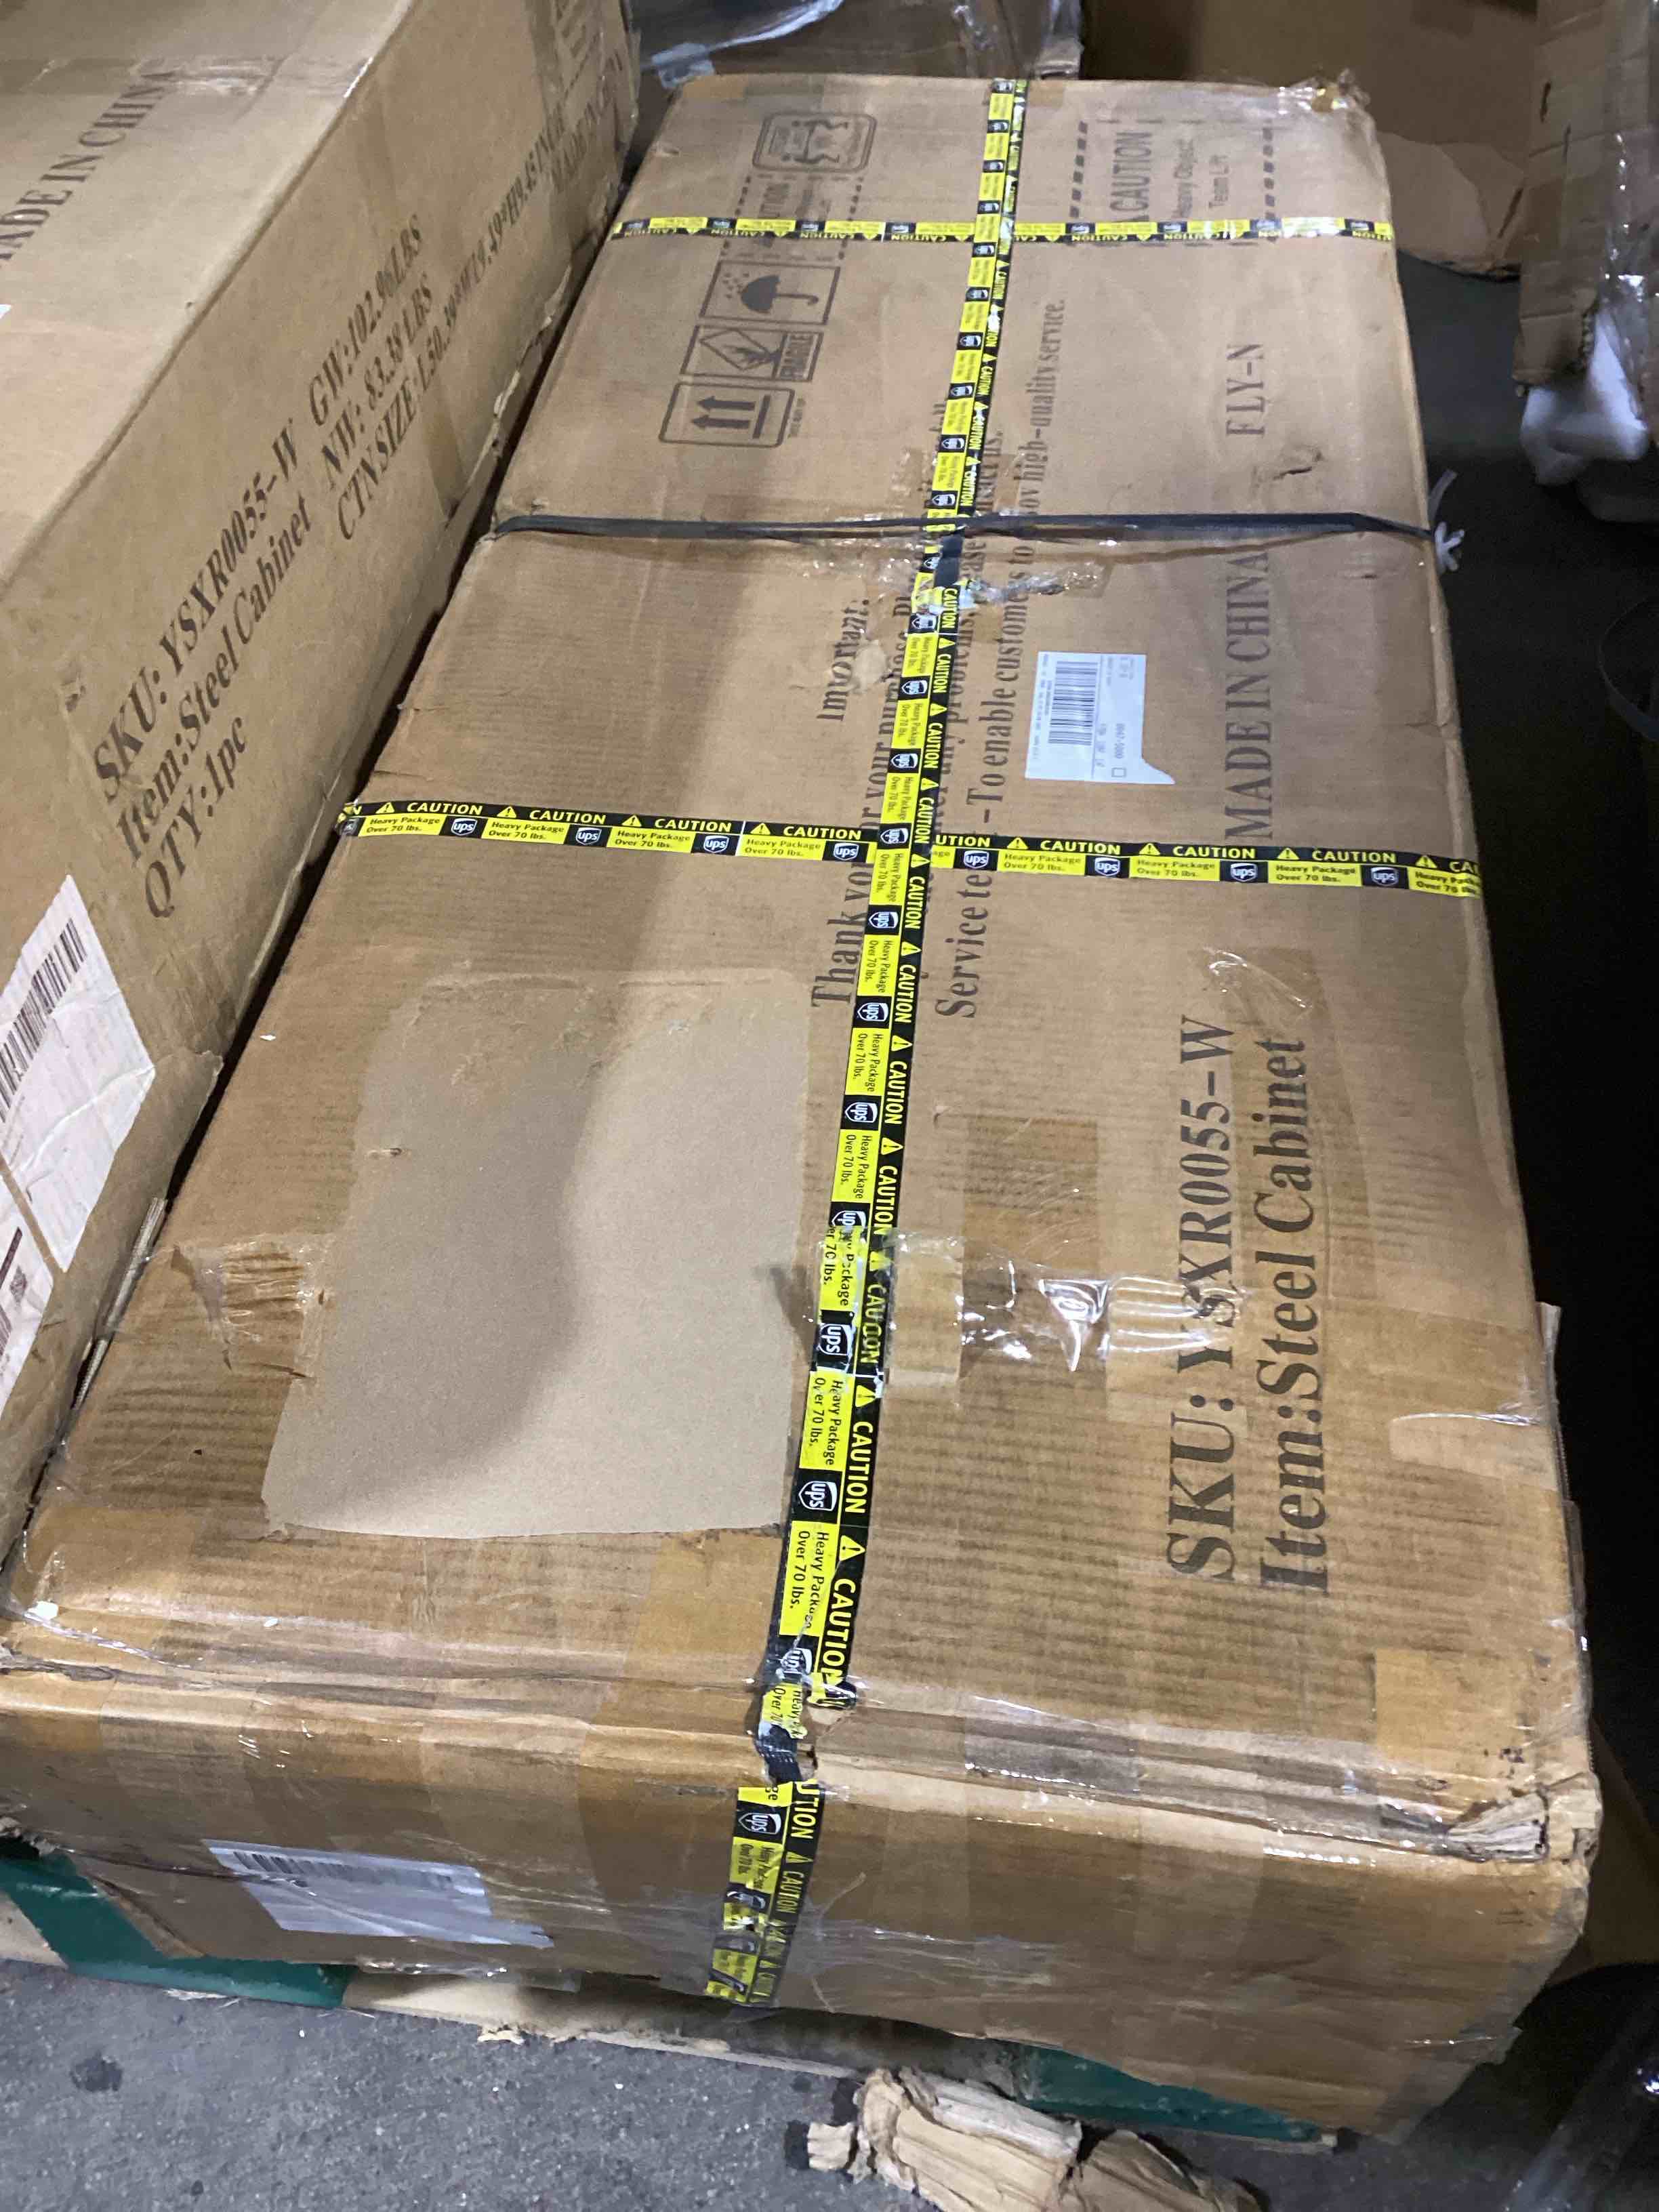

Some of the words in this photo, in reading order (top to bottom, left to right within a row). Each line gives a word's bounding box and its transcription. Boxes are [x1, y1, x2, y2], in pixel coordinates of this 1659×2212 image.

[39, 153, 105, 183] IN
[1110, 132, 1152, 211] CAUTION
[1227, 344, 1266, 437] FLY-N
[1008, 546, 1035, 564] to
[93, 667, 169, 804] SKU:
[158, 417, 298, 677] YSXR0055-W
[1226, 552, 1270, 663] CHINA
[995, 571, 1029, 682] customes
[116, 625, 239, 867] Item:Steel
[232, 489, 312, 645] Cabinet
[933, 653, 951, 693] CAUTION
[1226, 674, 1271, 712] IN
[978, 688, 1016, 766] enable
[924, 722, 943, 769] CAUTION
[1223, 720, 1272, 840] MADE
[143, 716, 248, 919] QTY:1pc
[407, 802, 483, 815] CAUTION
[529, 811, 606, 825] CAUTION
[914, 797, 935, 844] CAUTION
[454, 822, 474, 832] ups
[578, 831, 599, 842] ups
[655, 818, 731, 832] CAUTION
[783, 826, 862, 840] CAUTION
[705, 838, 726, 849] ups
[835, 846, 858, 857] ups
[935, 834, 991, 847] UTION
[1040, 840, 1121, 855] CAUTION
[1172, 846, 1256, 859] CAUTION
[966, 854, 987, 866] ups
[1096, 861, 1119, 873] ups
[1311, 850, 1397, 864] CAUTION
[1231, 867, 1254, 879] ups
[1374, 872, 1395, 884] ups
[905, 876, 925, 929] CAUTION
[874, 912, 889, 928] ups
[811, 911, 867, 1007] Thank
[867, 939, 879, 954] Over
[880, 939, 894, 962] Heavy
[865, 956, 877, 966] 70
[935, 906, 989, 1018] Service
[864, 969, 876, 981] lbs.
[876, 964, 891, 993] Package
[895, 964, 916, 1023] CAUTION
[862, 1002, 880, 1020] ups
[856, 1032, 868, 1048] Over
[869, 1032, 884, 1057] Heavy
[855, 1051, 866, 1062] 70
[853, 1065, 865, 1078] lbs.
[865, 1059, 882, 1092] Package
[884, 1061, 907, 1125] CAUTION
[850, 1102, 868, 1122] ups
[844, 1134, 856, 1151] Over
[857, 1134, 873, 1160] Heavy
[1252, 1040, 1315, 1235] Cabinet
[842, 1154, 855, 1166] 70
[840, 1168, 853, 1184] lbs.
[854, 1162, 871, 1199] Package
[874, 1165, 898, 1235] CAUTION
[838, 1254, 855, 1307] Pckage
[821, 1326, 842, 1353] ups
[814, 1378, 830, 1404] Over
[830, 1380, 848, 1418] Heavy
[811, 1406, 826, 1423] 70
[1254, 1251, 1330, 1594] Item:Steel
[808, 1426, 824, 1446] lbs.
[824, 1419, 844, 1466] Package
[845, 1421, 873, 1514] CAUTION
[804, 1481, 825, 1509] ups
[1166, 1393, 1235, 1581] SKU:
[792, 1531, 811, 1558] Over
[813, 1532, 830, 1571] Heavy
[792, 1565, 806, 1581] 70
[790, 1586, 806, 1608] lbs.
[791, 1783, 820, 1839] UTION
[777, 1870, 804, 1914] CAUTION
